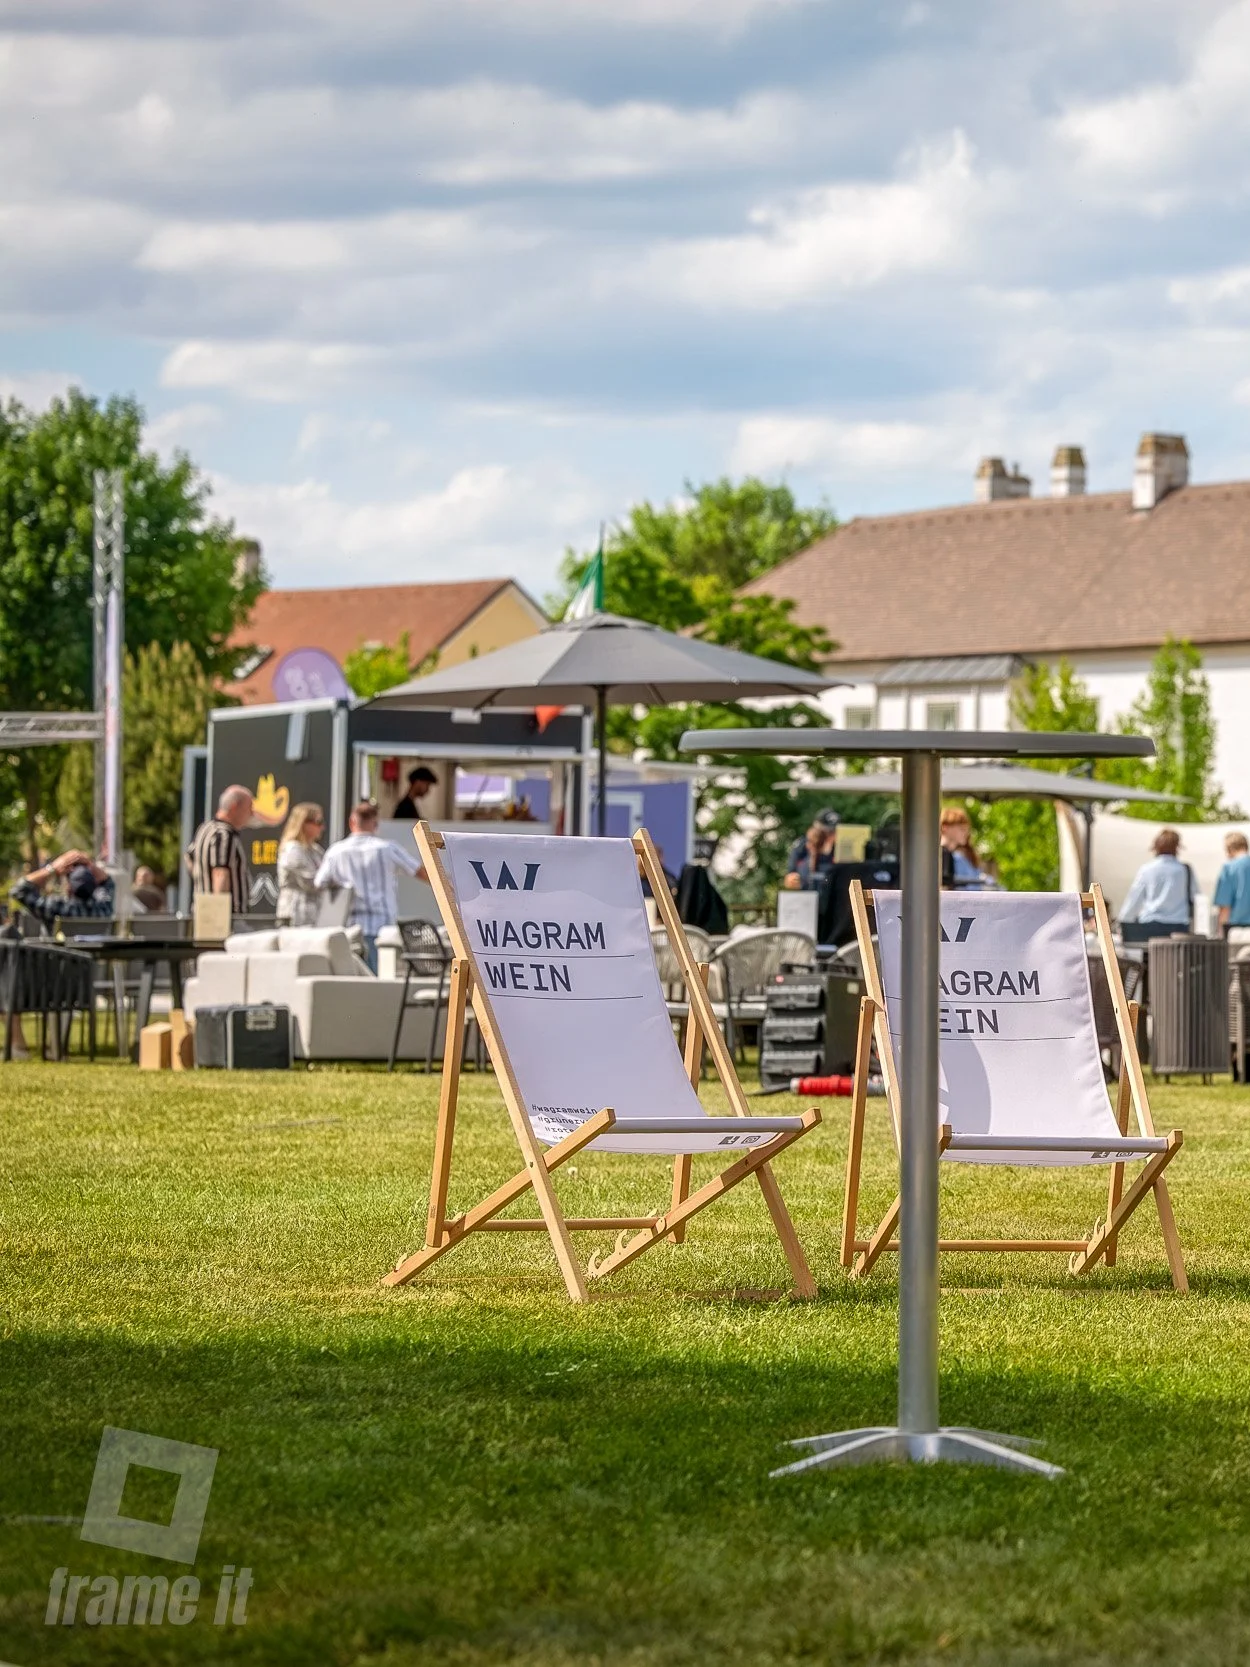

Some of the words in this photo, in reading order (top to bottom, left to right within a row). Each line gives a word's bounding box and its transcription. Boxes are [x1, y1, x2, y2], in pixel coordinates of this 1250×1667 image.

[476, 918, 606, 950] WAGRAM
[484, 961, 572, 992] WEIN
[939, 970, 1041, 996] AGRAM
[939, 1008, 1000, 1034] EIN
[531, 1103, 598, 1115] #wagramwein
[537, 1115, 589, 1125] #grünerv
